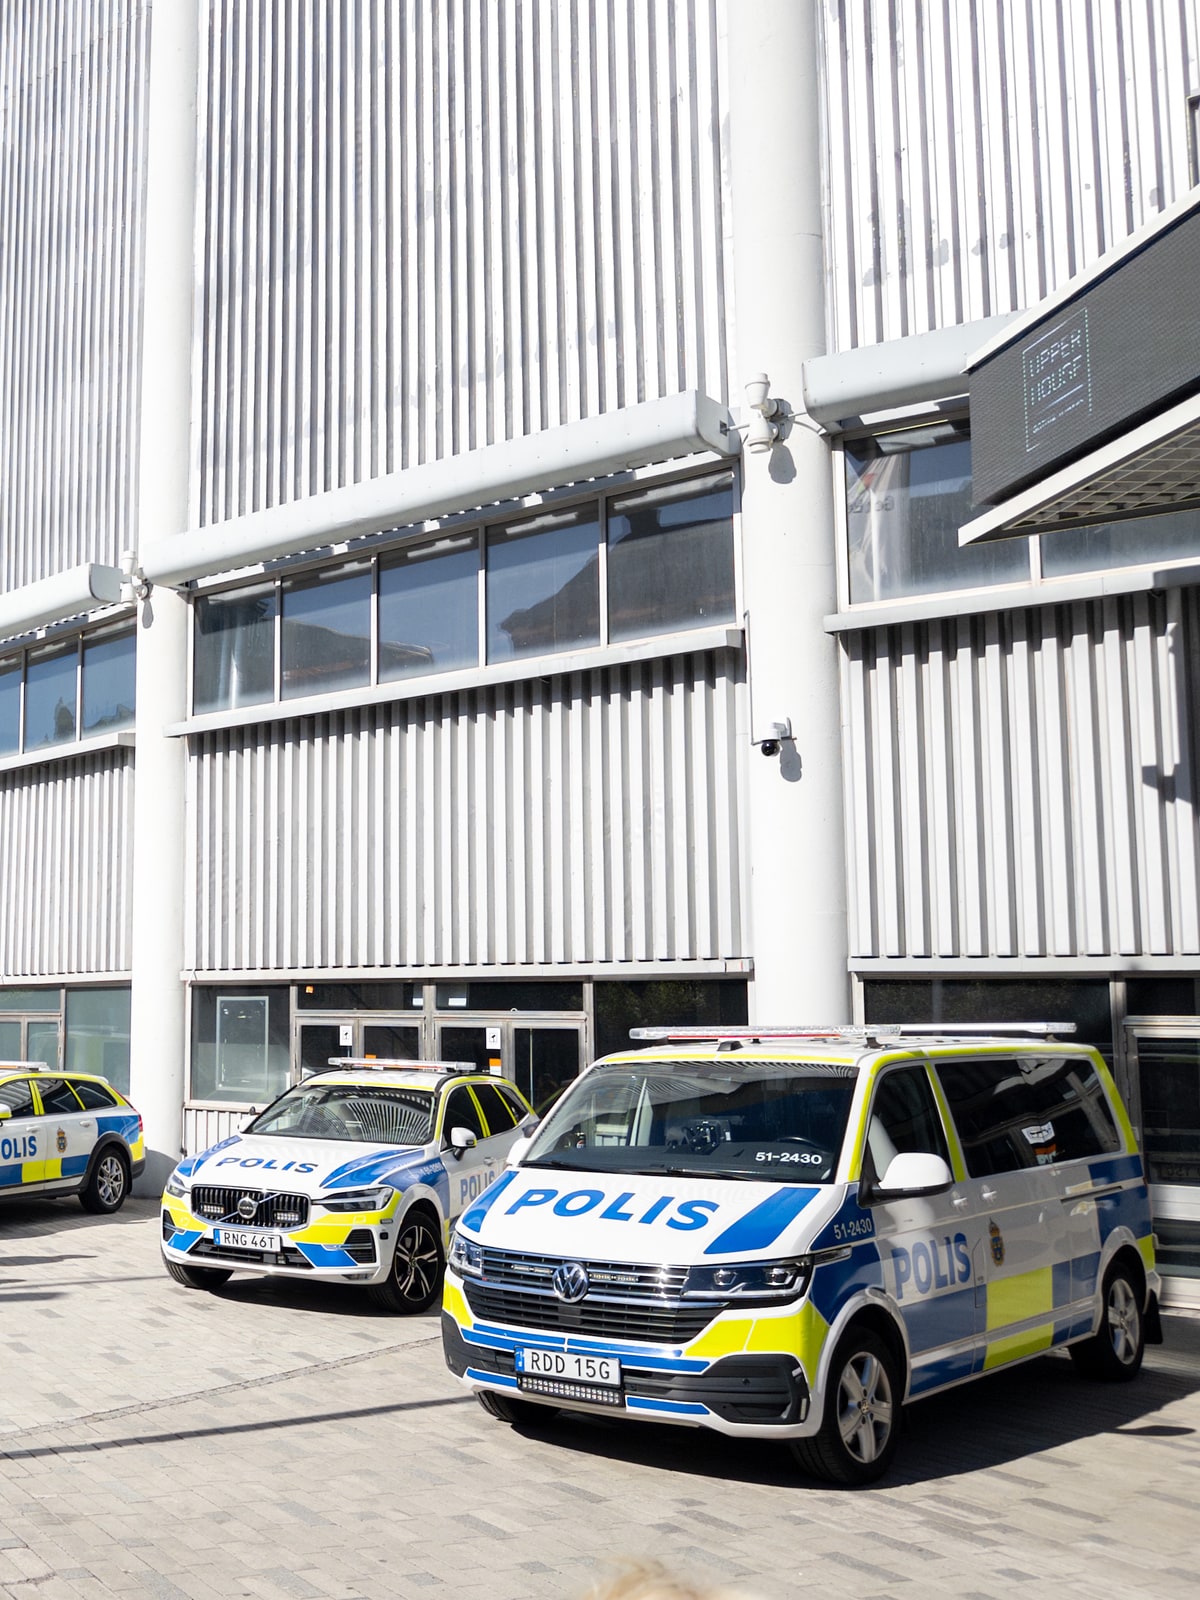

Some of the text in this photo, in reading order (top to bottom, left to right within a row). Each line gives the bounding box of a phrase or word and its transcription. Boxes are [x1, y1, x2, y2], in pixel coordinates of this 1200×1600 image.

[216, 1157, 319, 1174] POLIS
[754, 1151, 823, 1166] 51-2430
[504, 1189, 720, 1231] POLIS
[833, 1217, 873, 1240] 51-2430
[223, 1232, 276, 1249] RNG 46T
[890, 1232, 971, 1300] POLIS
[530, 1351, 611, 1381] RDD 15G
